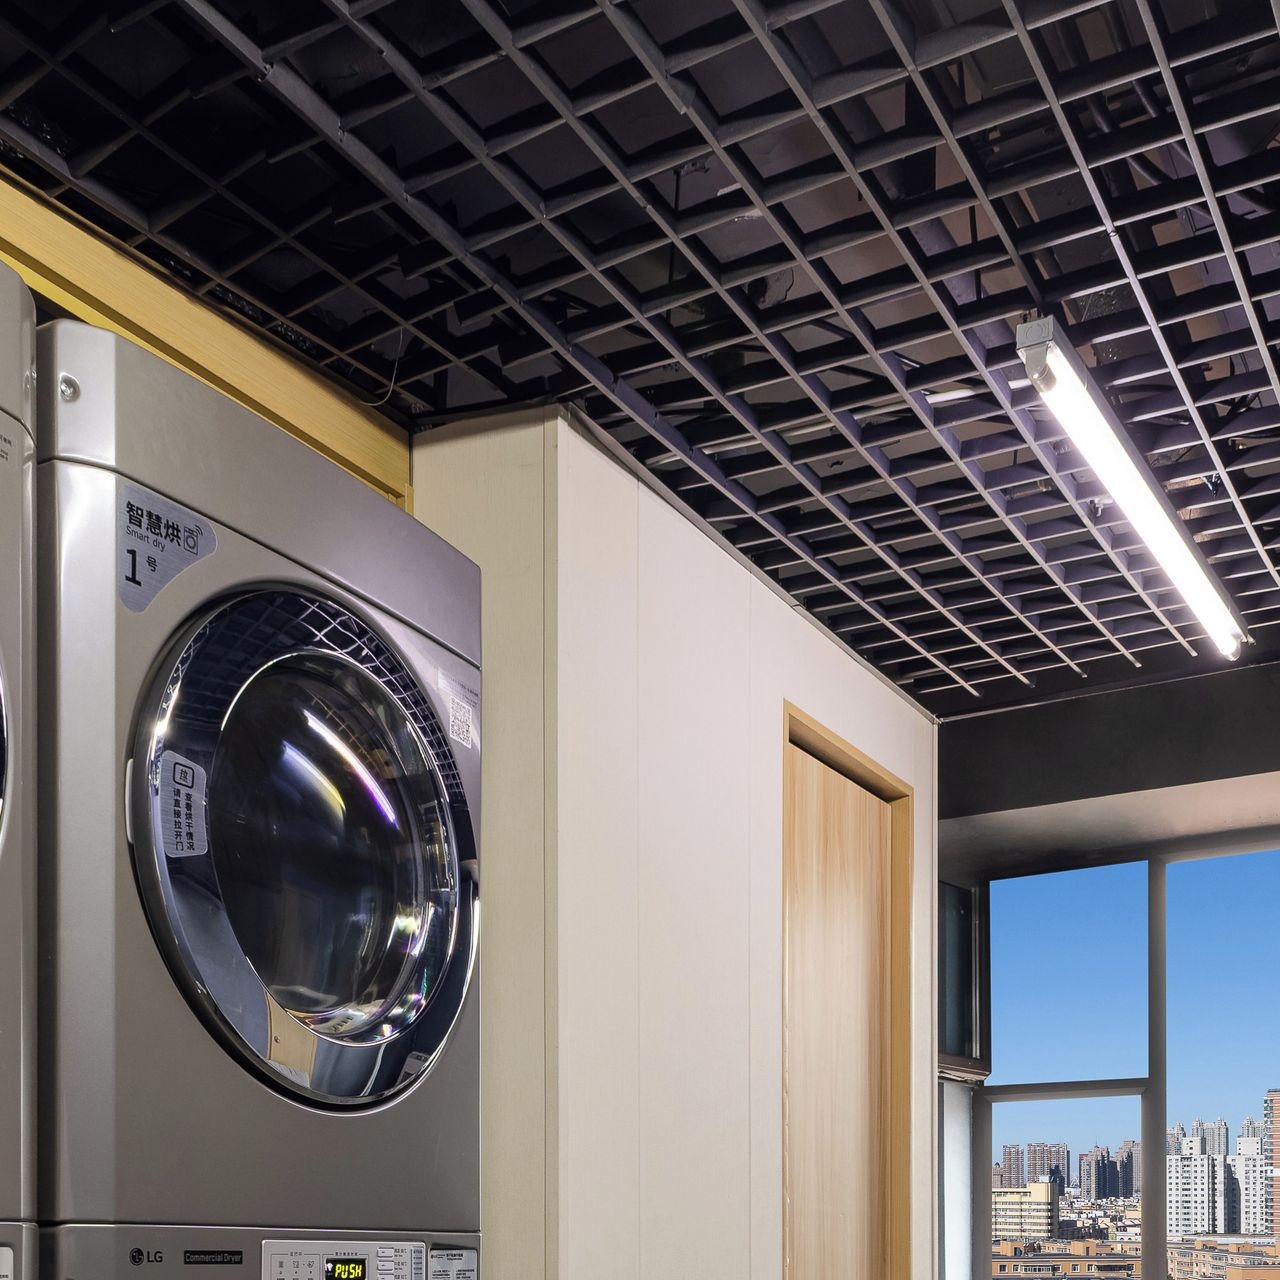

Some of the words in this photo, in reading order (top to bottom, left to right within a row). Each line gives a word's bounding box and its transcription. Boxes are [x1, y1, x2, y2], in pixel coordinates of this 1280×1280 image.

[126, 500, 181, 547] 智慧烘
[126, 526, 150, 544] Smart
[153, 539, 166, 552] dry
[125, 549, 142, 587] 1
[146, 556, 158, 572] 号
[147, 1251, 163, 1263] LG
[185, 1252, 222, 1262] Commercial
[224, 1253, 241, 1264] Dryer
[335, 1264, 362, 1279] PUSH
